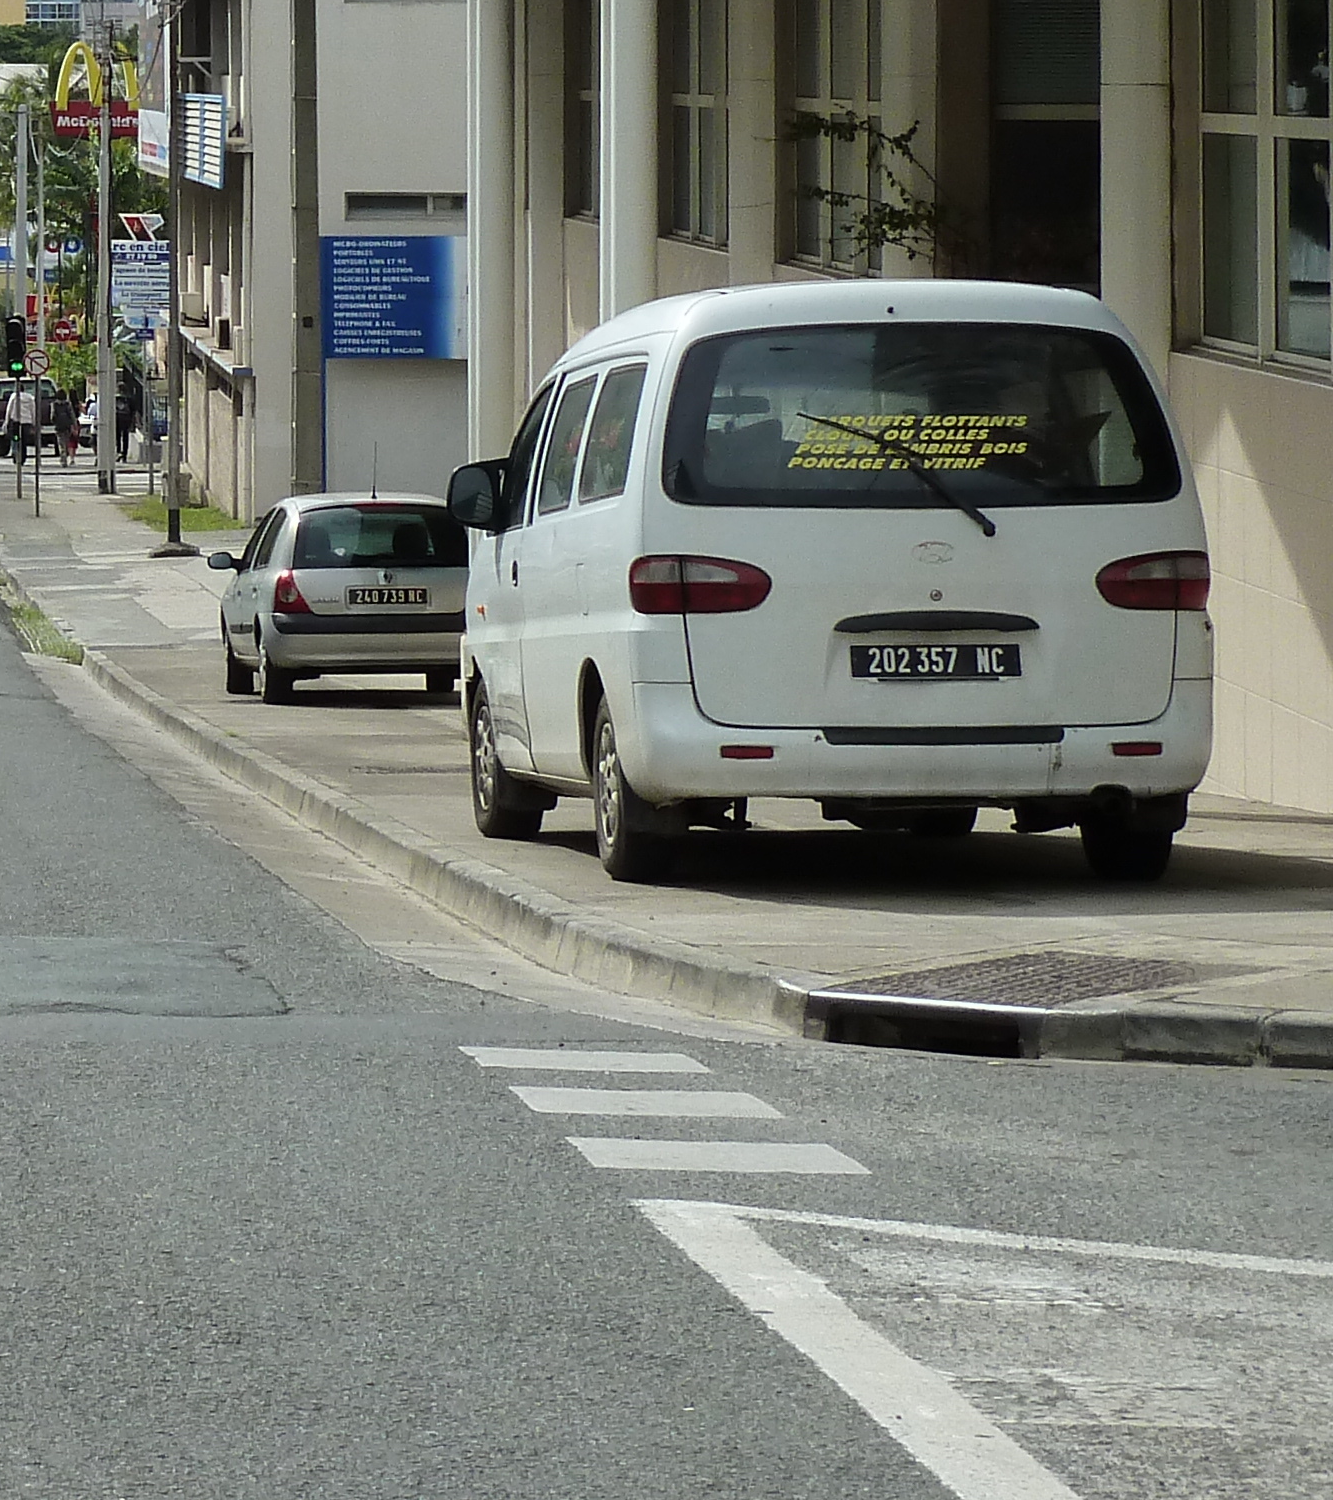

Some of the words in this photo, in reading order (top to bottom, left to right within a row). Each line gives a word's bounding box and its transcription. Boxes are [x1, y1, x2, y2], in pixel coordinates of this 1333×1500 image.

[920, 415, 1027, 427] FLOTTANTS
[883, 429, 915, 441] OU
[919, 429, 990, 440] COLLES
[795, 443, 849, 455] POSE
[852, 443, 881, 455] DE
[979, 442, 1028, 454] BOIS
[787, 457, 886, 470] PONCAGE
[923, 457, 986, 469] VITRIF
[356, 590, 379, 603] 240
[382, 590, 405, 603] 739
[408, 590, 423, 603] NC
[868, 647, 911, 673] 202
[916, 647, 958, 673] 357
[976, 647, 1004, 673] NC
